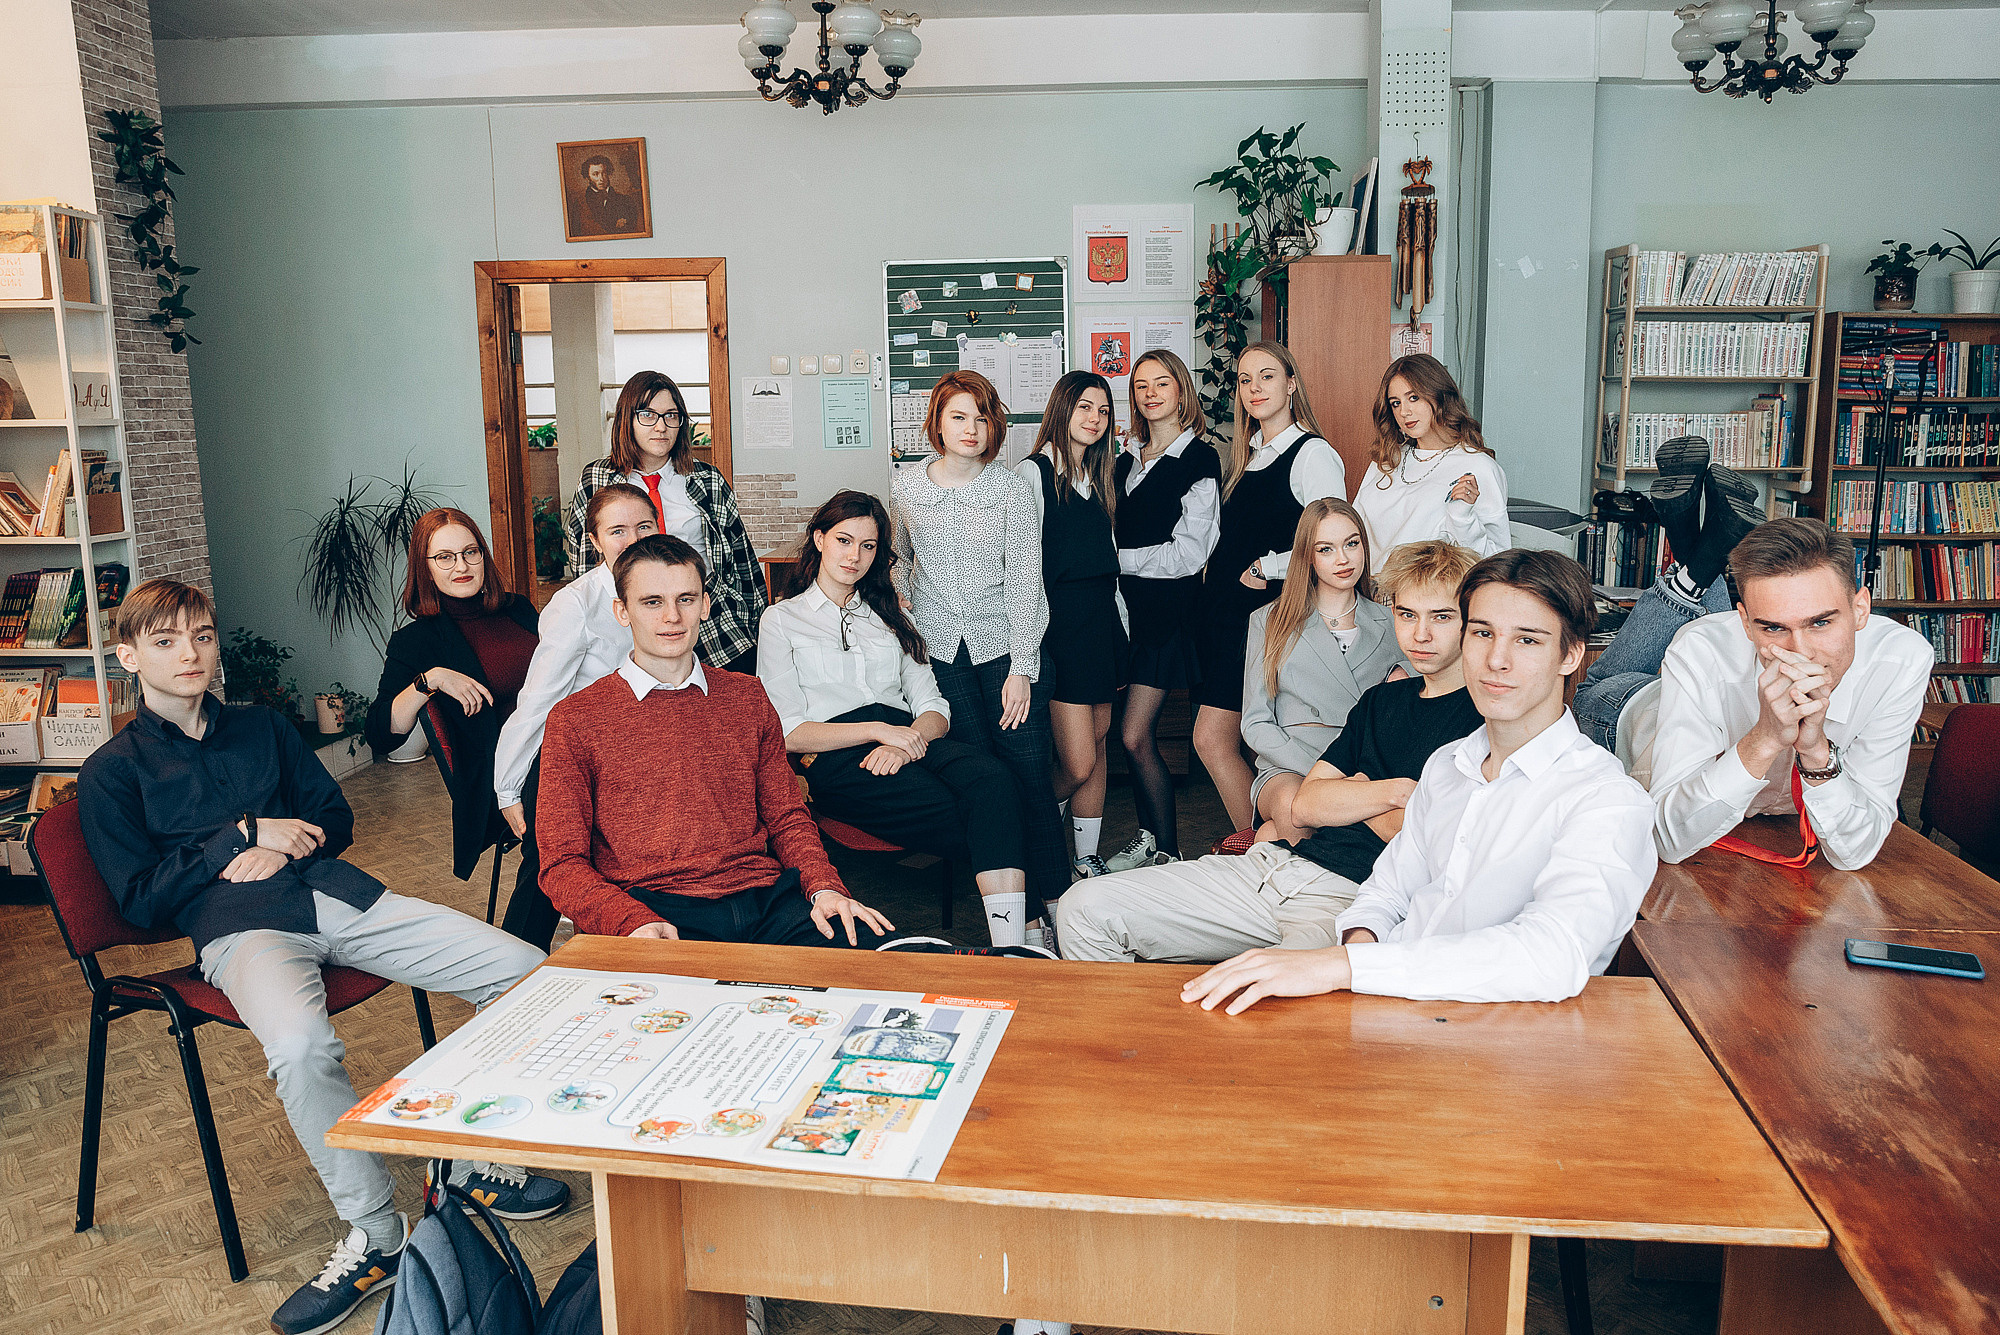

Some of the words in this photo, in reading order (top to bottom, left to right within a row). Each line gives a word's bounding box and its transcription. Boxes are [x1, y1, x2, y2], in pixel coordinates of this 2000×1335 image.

[47, 720, 102, 734] ЧИТАЕМ
[54, 735, 96, 747] САМИ
[981, 1010, 1001, 1030] Сказки
[966, 1030, 991, 1061] писателей
[765, 1048, 809, 1091] ПРОЧИТАЙТЕ
[954, 1061, 976, 1084] России
